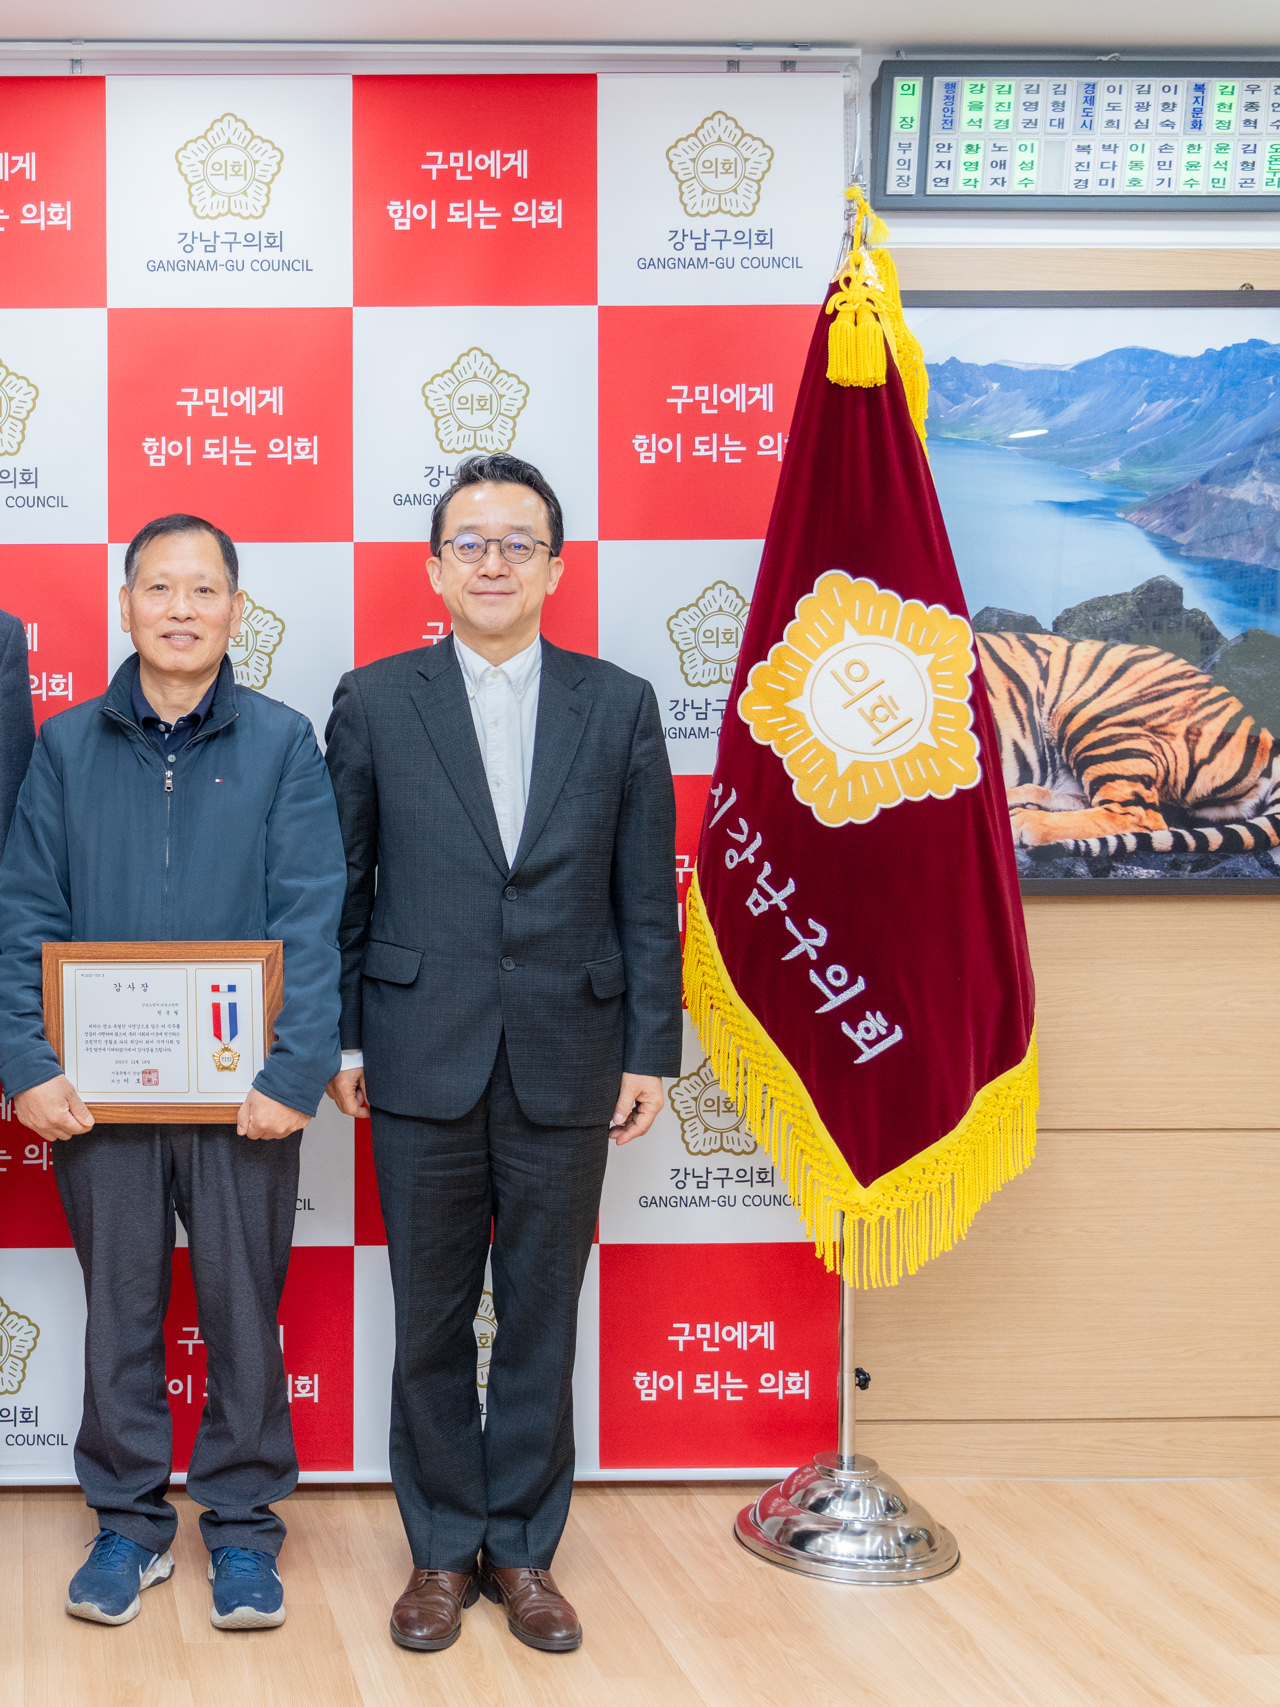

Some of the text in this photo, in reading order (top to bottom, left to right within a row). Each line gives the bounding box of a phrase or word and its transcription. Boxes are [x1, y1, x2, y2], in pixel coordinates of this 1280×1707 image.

[899, 83, 916, 129] 의장
[941, 82, 956, 130] 행정안전
[993, 84, 1012, 130] 김진경
[1021, 83, 1040, 129] 김영권
[1049, 83, 1067, 130] 김형대
[1080, 83, 1095, 130] 경제도시
[1104, 84, 1122, 130] 이도희
[1133, 84, 1151, 129] 김광심
[1159, 84, 1178, 130] 이향숙
[1190, 83, 1206, 130] 복지문화
[1215, 84, 1235, 130] 김현정
[1242, 84, 1262, 129] 우종혁
[209, 158, 248, 181] 의회
[420, 149, 530, 181] 구민에게
[701, 155, 740, 178] 의회
[895, 142, 913, 188] 부의장
[933, 142, 953, 188] 안지연
[962, 143, 981, 189] 황영각
[989, 142, 1009, 187] 노애자
[1017, 142, 1035, 188] 이성수
[1073, 144, 1092, 190] 복진경
[1098, 143, 1119, 188] 박다미
[1126, 143, 1145, 188] 이동호
[1155, 143, 1175, 188] 손민기
[1183, 143, 1202, 188] 한윤수
[1211, 143, 1231, 188] 윤석민
[1238, 143, 1257, 188] 김형곤
[20, 200, 72, 231] 의회
[386, 198, 564, 231] 힘이 되는 의회
[176, 230, 283, 253] 강남구의회
[668, 227, 775, 250] 강남구의회
[145, 258, 313, 273] GANGNAM-GU COUNCIL
[637, 255, 805, 270] GANGNAM-GU COUNCIL
[175, 385, 285, 417] 구민에게
[456, 392, 495, 415] 의회
[666, 383, 776, 415] 구민에게
[141, 434, 319, 467] 힘이 되는 의회
[632, 433, 789, 465] 힘이 되는 의
[5, 494, 68, 508] COUNCIL
[393, 493, 442, 506] GANGN
[702, 627, 739, 648] 의회
[30, 672, 72, 701] 의회
[831, 658, 913, 747] 의회
[668, 698, 729, 721] 강남구
[703, 1095, 741, 1118] 의회
[23, 1141, 53, 1171] 의
[670, 1166, 775, 1190] 강남구의회
[638, 1195, 737, 1208] GANGNAM-GU
[667, 1321, 775, 1353] 구민에게
[167, 1374, 192, 1404] 이
[633, 1370, 811, 1402] 힘이 되는 의회
[5, 1434, 68, 1447] COUNCIL
